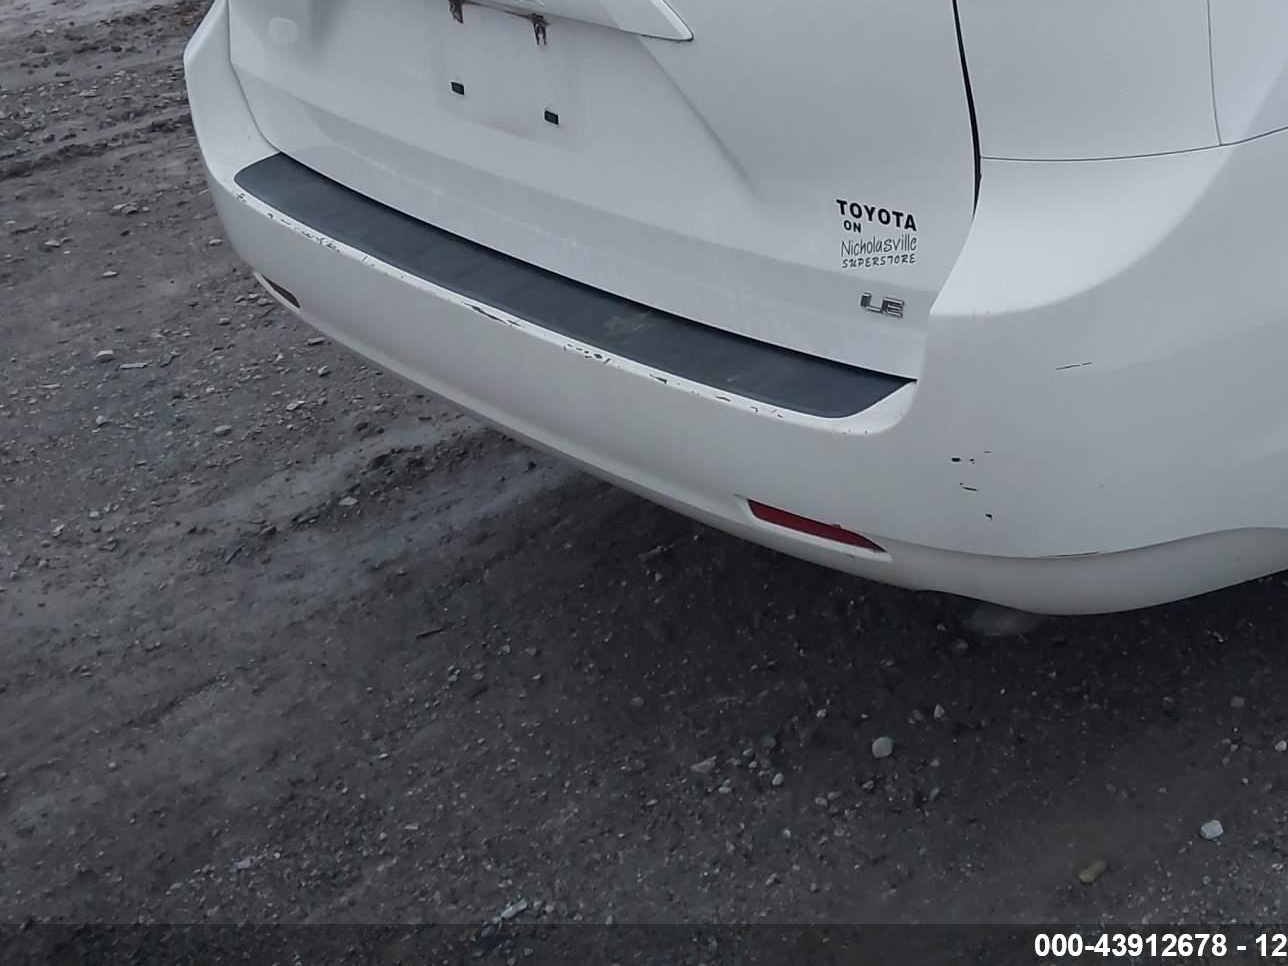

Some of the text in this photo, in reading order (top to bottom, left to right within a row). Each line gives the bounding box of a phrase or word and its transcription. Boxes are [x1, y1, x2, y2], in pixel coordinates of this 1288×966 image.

[836, 199, 917, 232] TOYOTA
[843, 220, 862, 233] ON
[841, 233, 917, 257] Nicholasville
[842, 253, 916, 269] SUPERSTORE
[860, 292, 905, 318] LE
